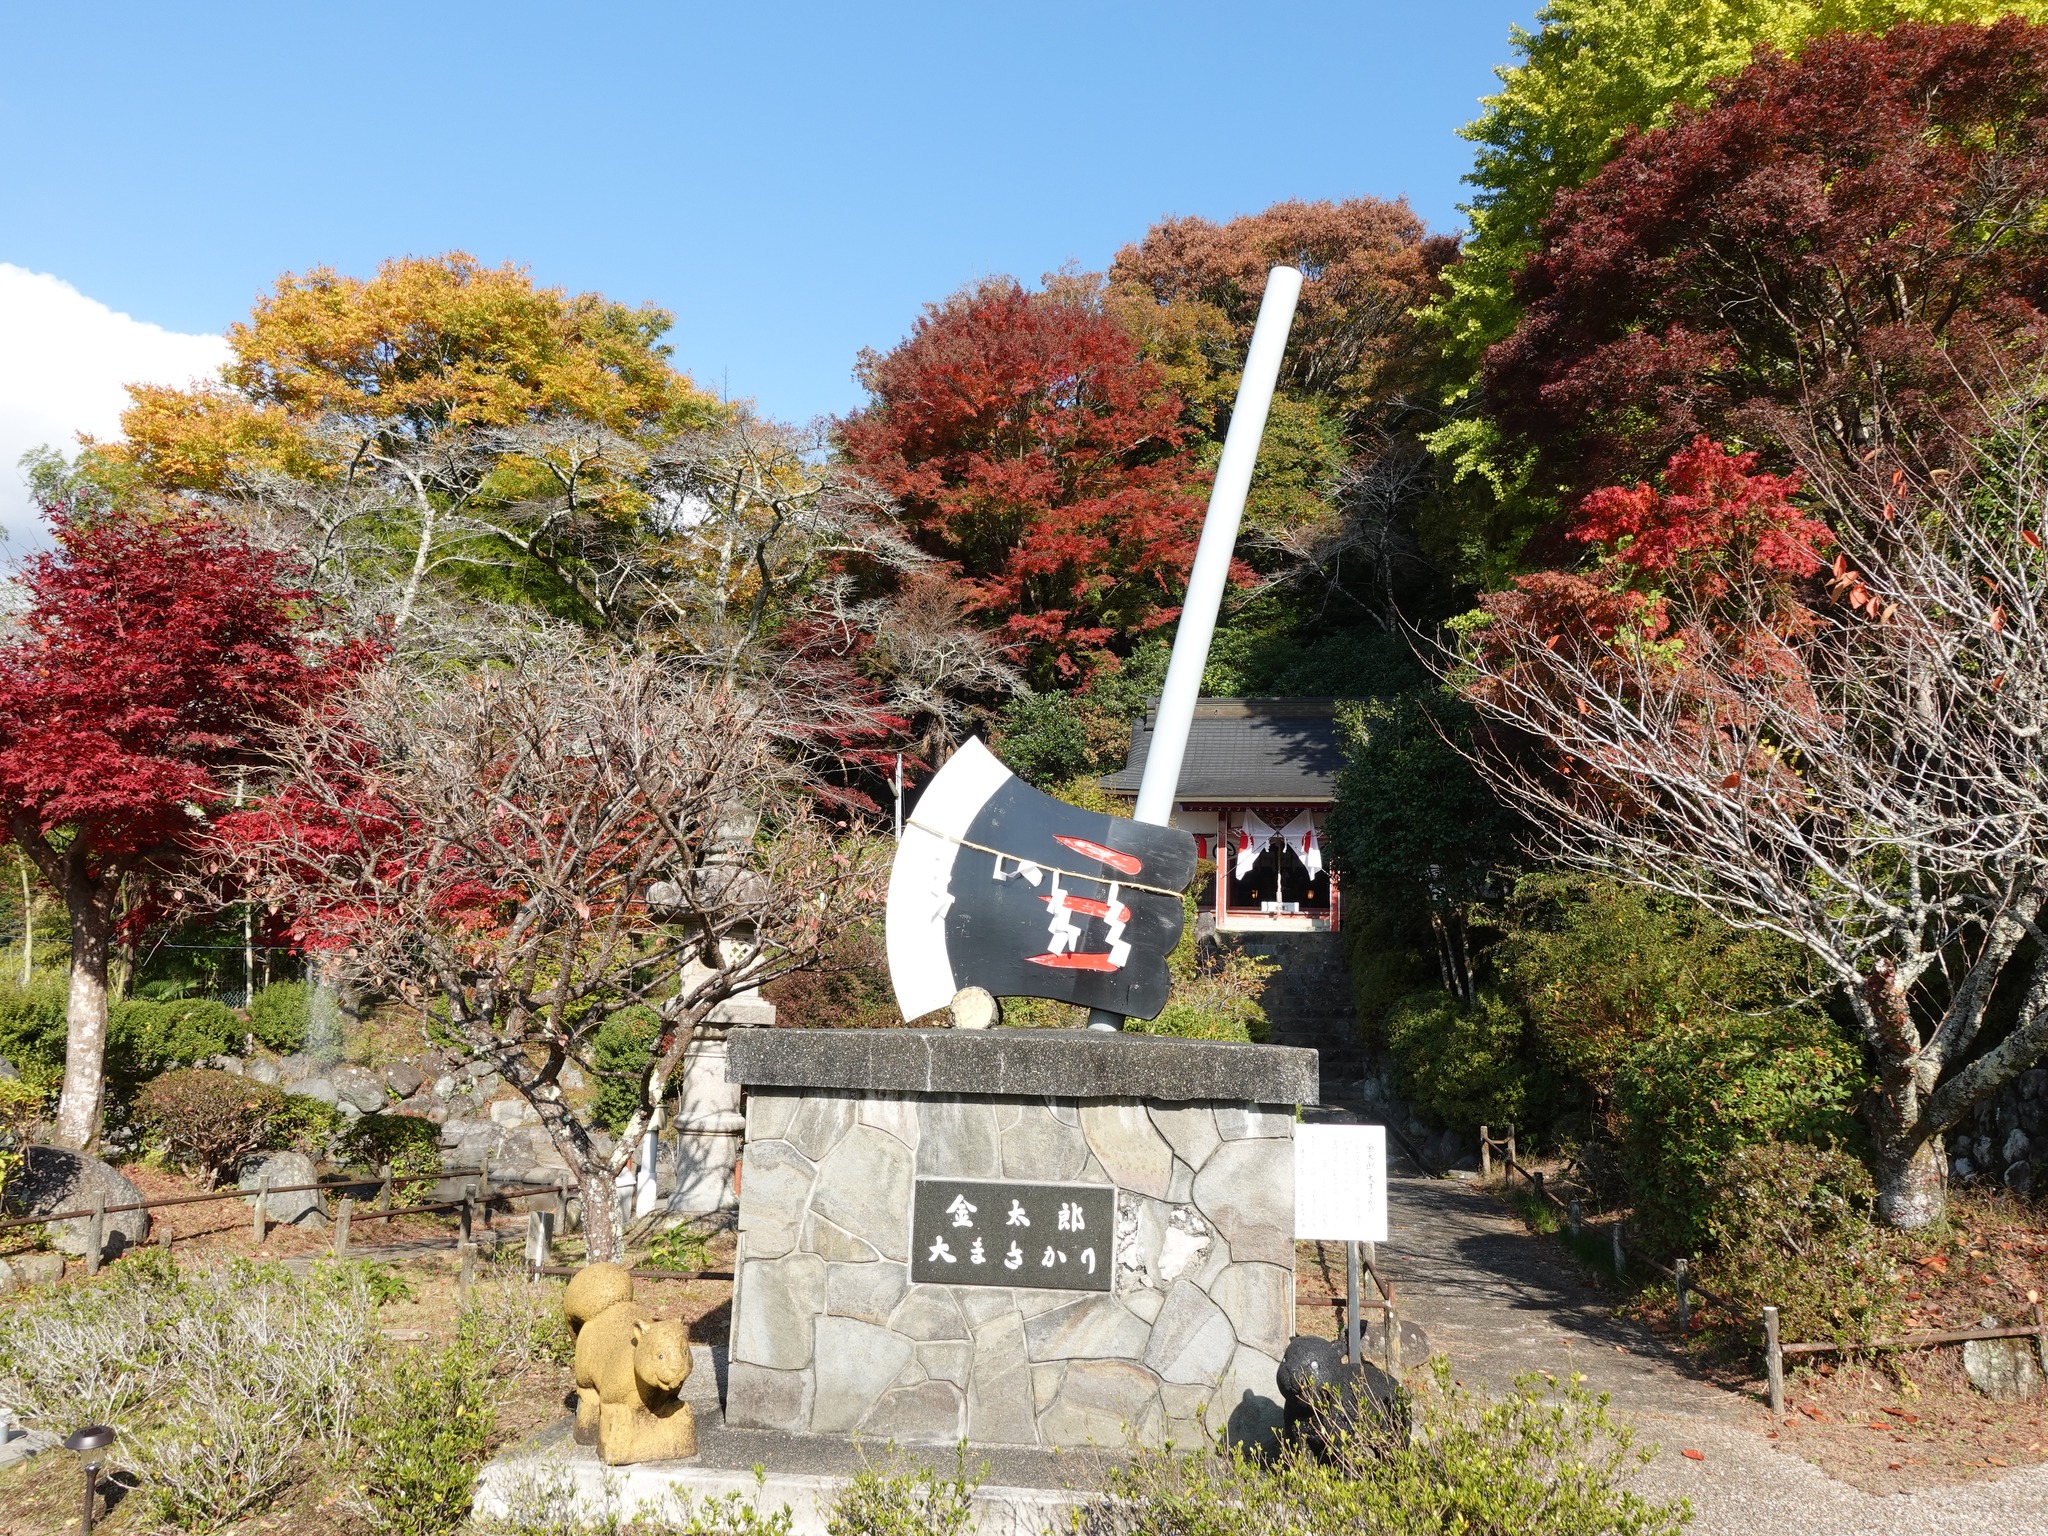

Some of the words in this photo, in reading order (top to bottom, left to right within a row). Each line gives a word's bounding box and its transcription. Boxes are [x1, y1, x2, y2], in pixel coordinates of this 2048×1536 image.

[946, 1194, 1085, 1232] 金太郎
[928, 1235, 1096, 1274] 大まさかり
